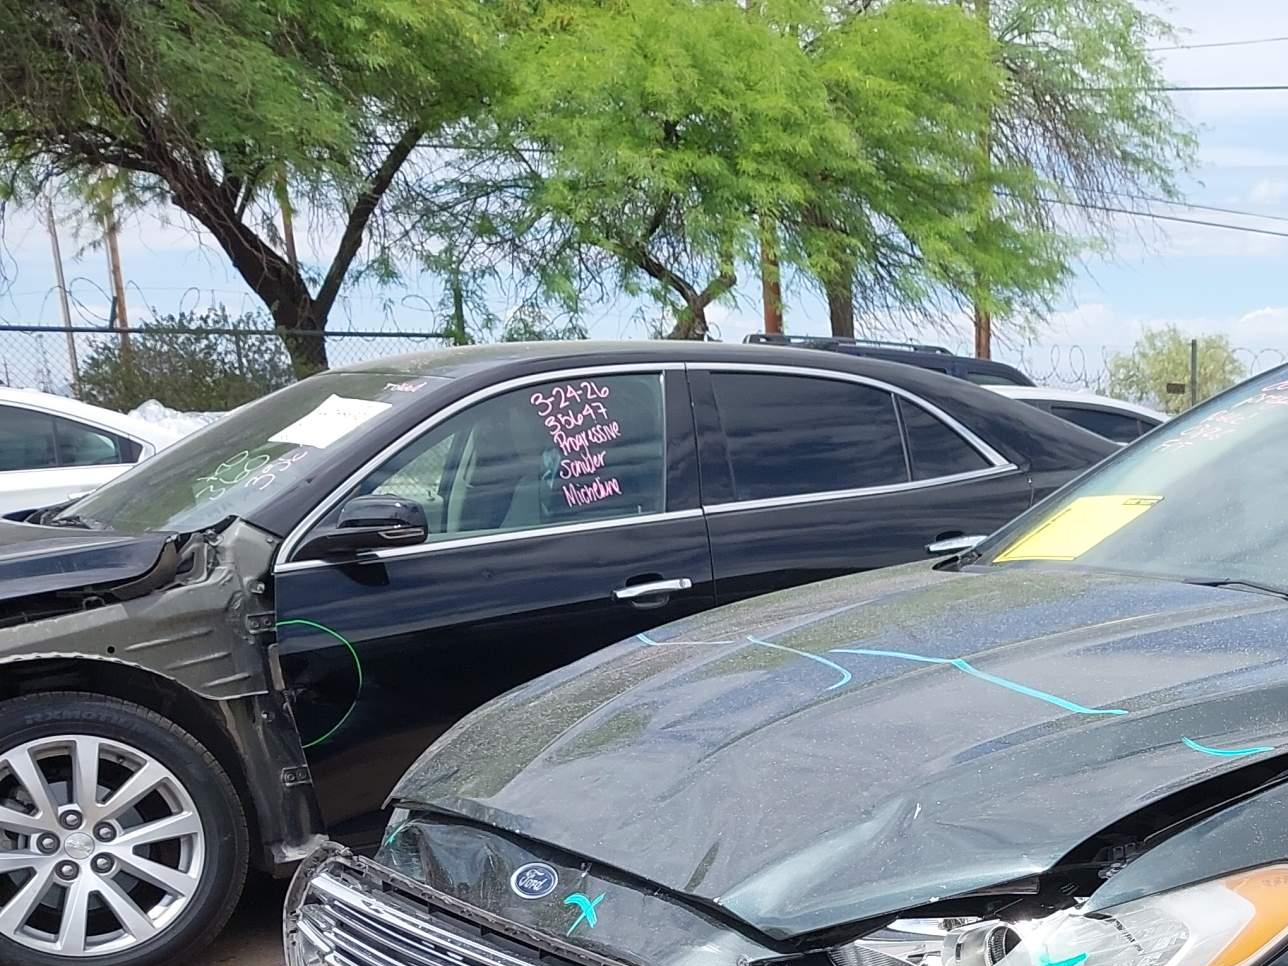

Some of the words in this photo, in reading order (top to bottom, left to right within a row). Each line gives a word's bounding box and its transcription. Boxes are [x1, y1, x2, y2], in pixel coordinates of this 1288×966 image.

[530, 382, 609, 416] 3-24-26
[545, 403, 608, 435] 35647
[553, 421, 621, 456] Progressive
